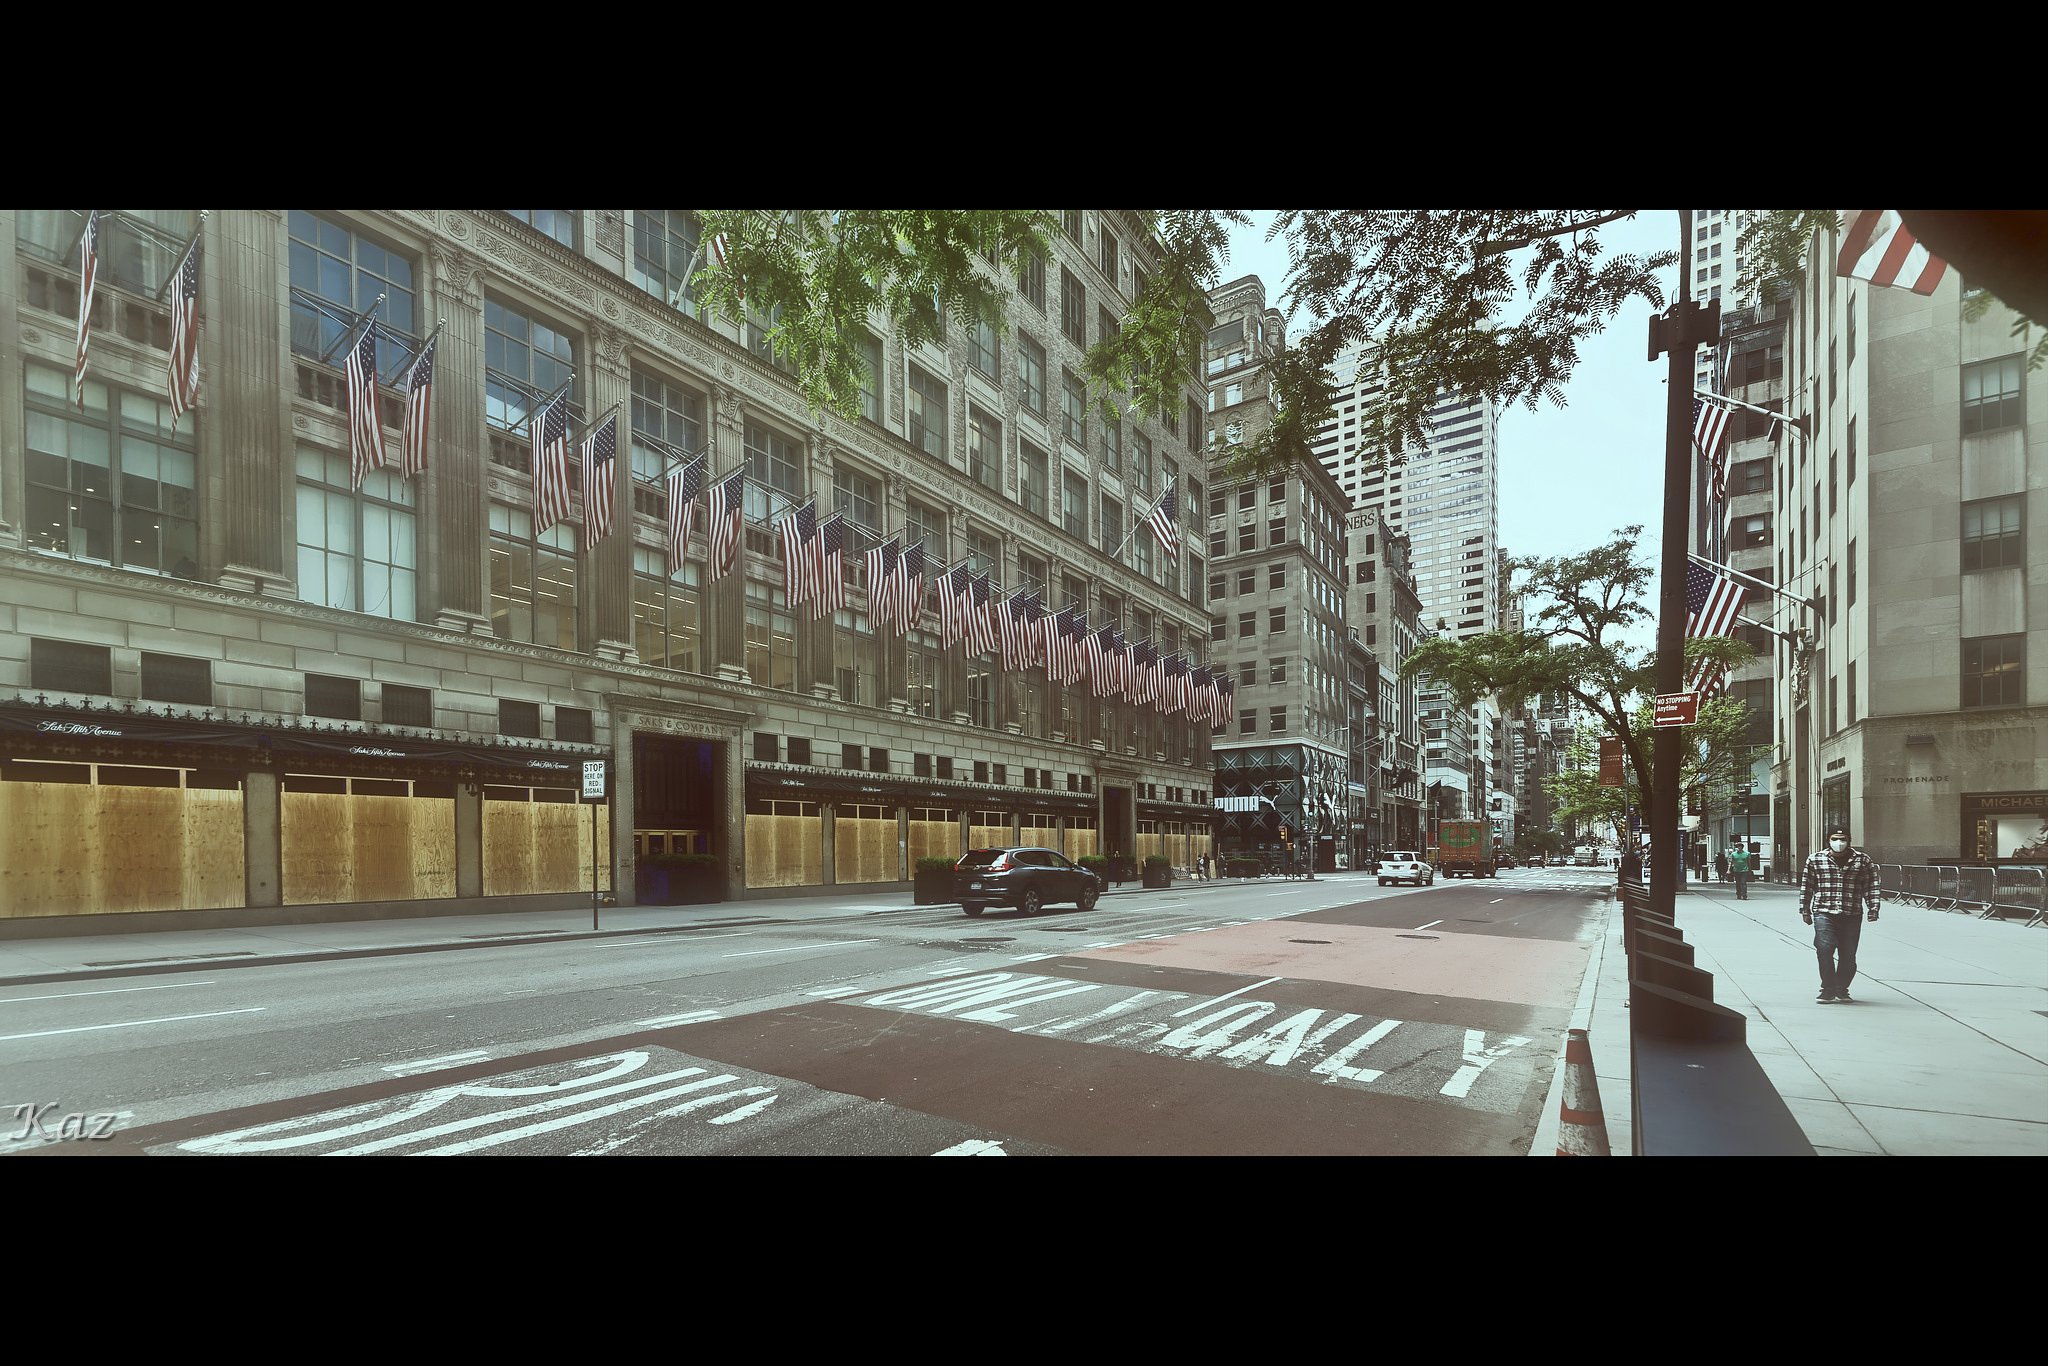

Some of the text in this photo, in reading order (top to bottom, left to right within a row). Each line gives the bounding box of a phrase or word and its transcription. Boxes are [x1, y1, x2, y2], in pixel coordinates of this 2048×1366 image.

[1665, 696, 1691, 704] STOPPING
[1657, 705, 1678, 713] Anytime
[37, 720, 122, 736] Saks Fifth Avenue
[639, 717, 663, 727] SAKS
[676, 722, 724, 735] COMPANY
[349, 746, 368, 754] Saks
[382, 748, 405, 756] Avenue
[584, 763, 603, 772] STOP
[1883, 775, 1950, 784] PROMENADE
[1214, 796, 1259, 812] PUMA
